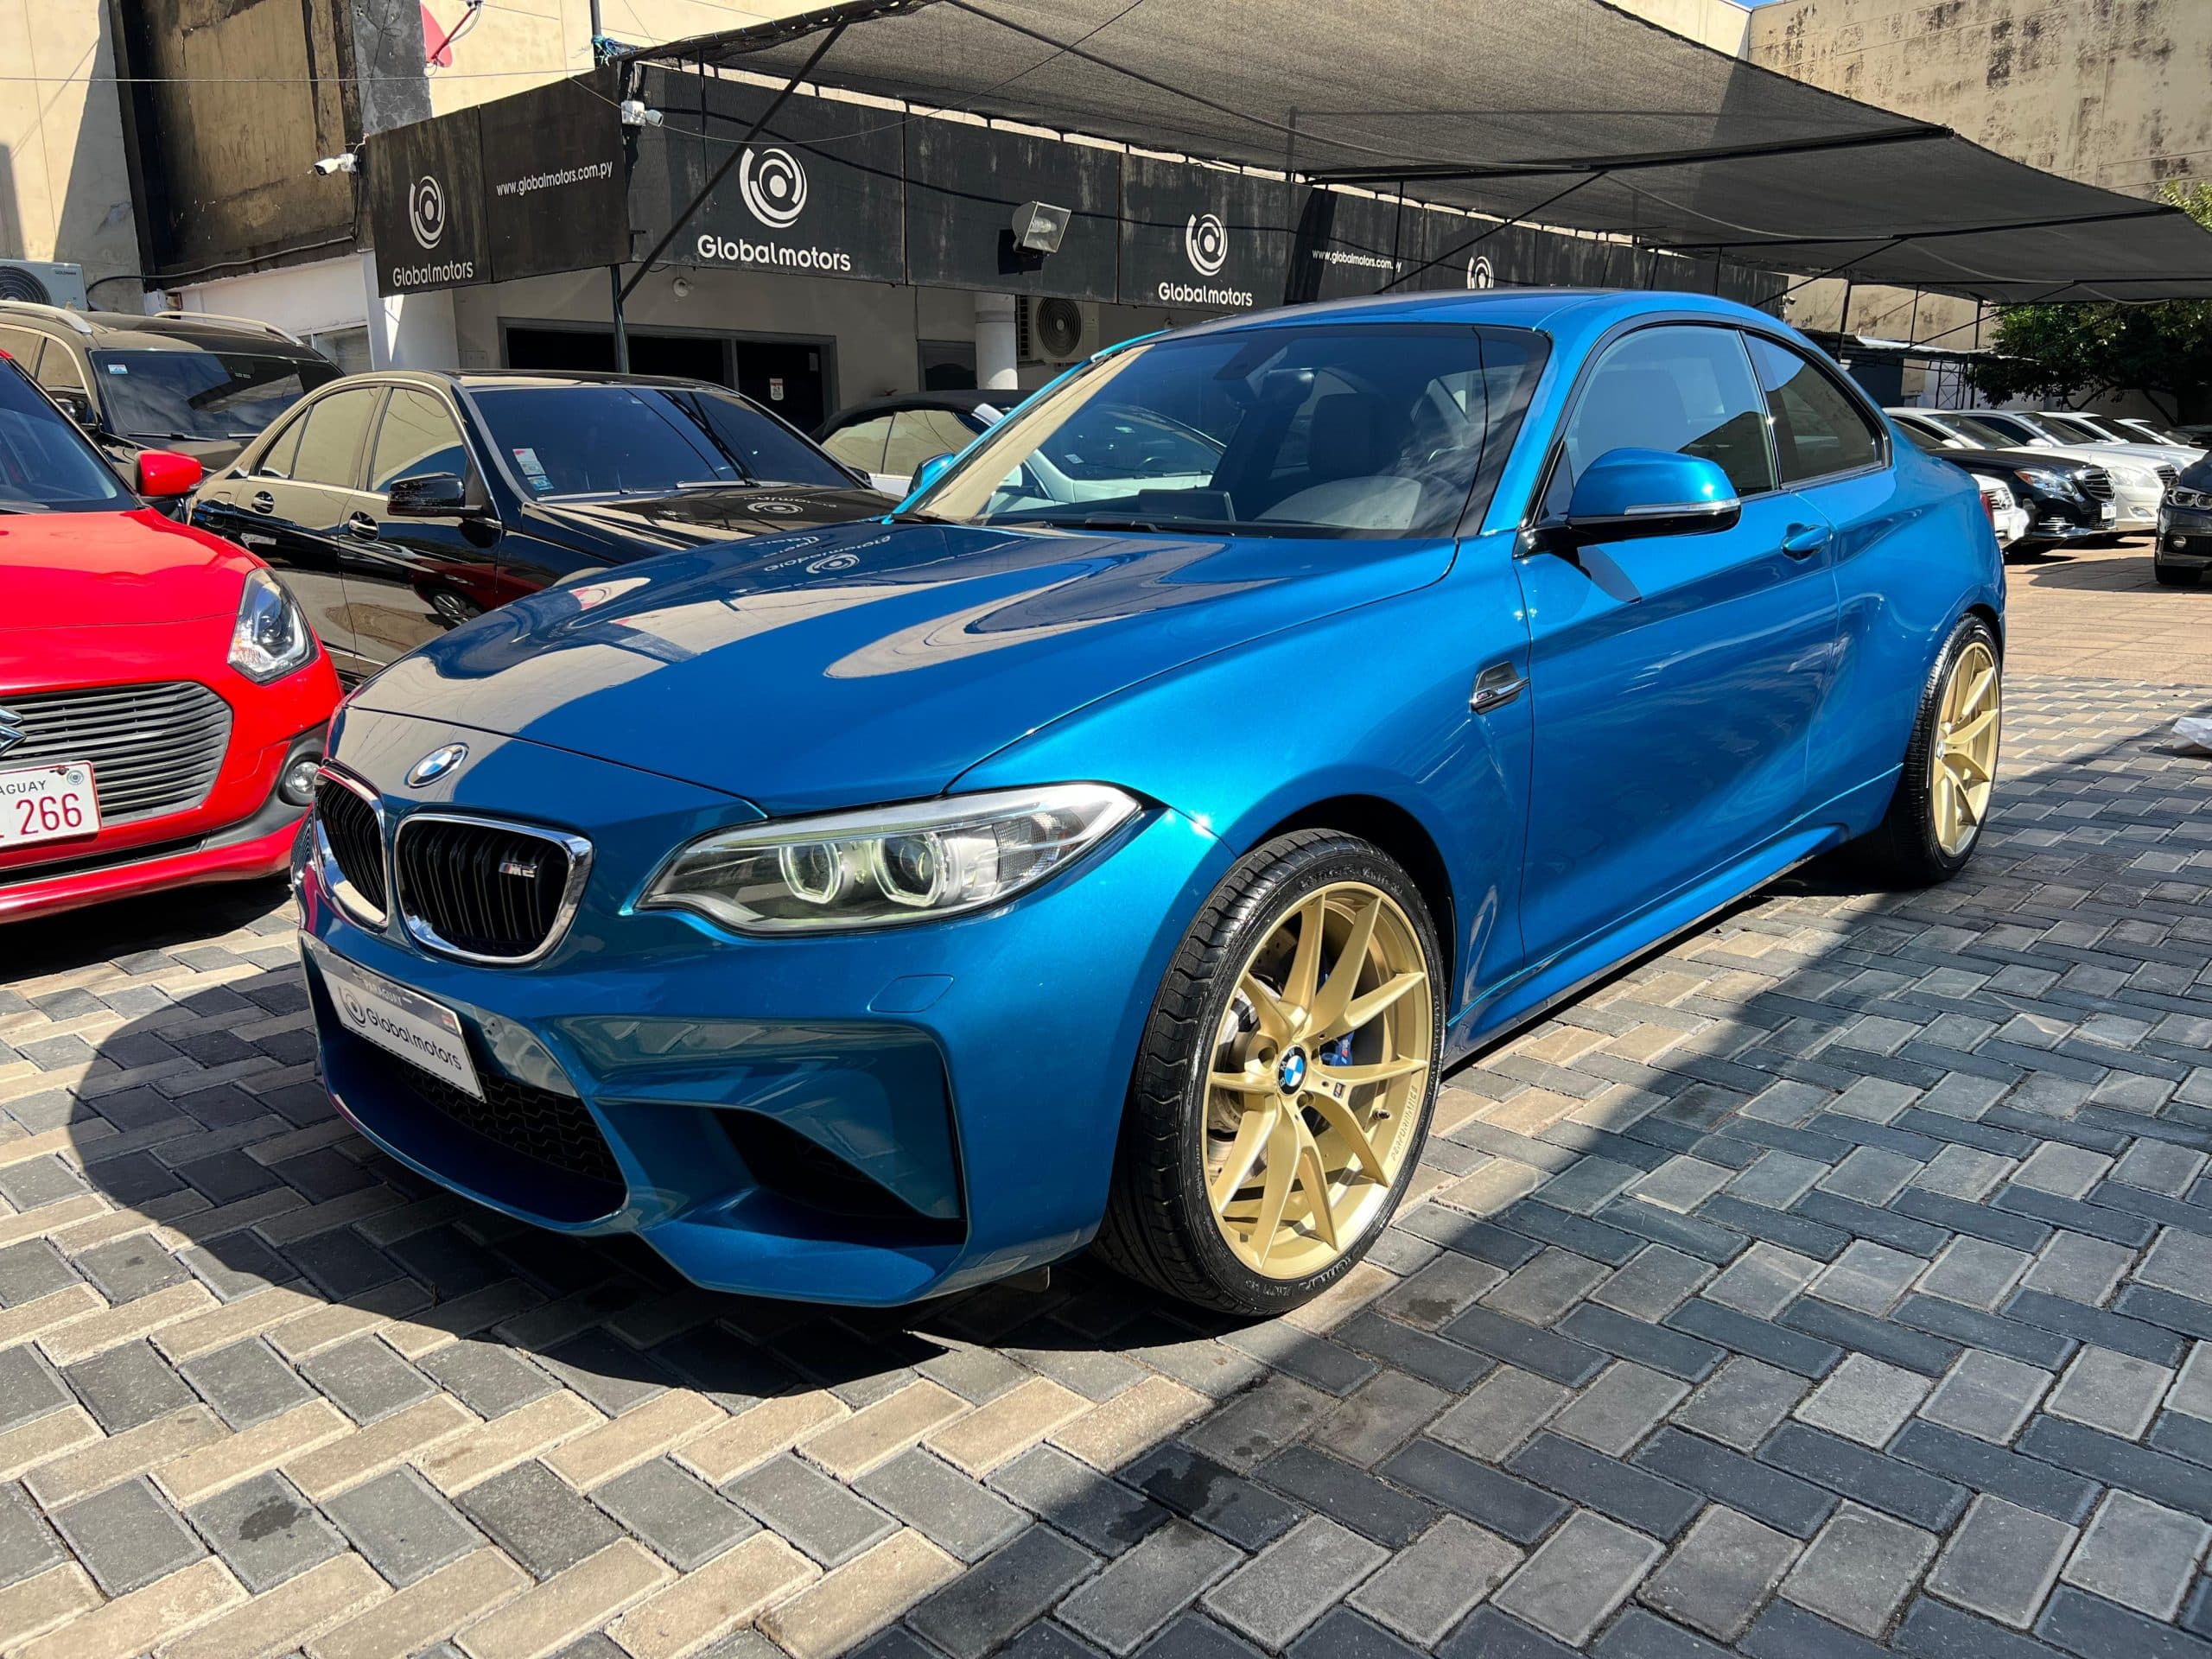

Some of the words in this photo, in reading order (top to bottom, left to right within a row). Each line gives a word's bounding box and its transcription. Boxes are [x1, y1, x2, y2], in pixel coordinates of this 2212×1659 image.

[496, 161, 613, 196] www.globalmotors.com.py
[697, 234, 851, 271] Globalmotors
[1312, 249, 1402, 273] www.globalmotors.com.y
[392, 260, 474, 287] Globalmotors
[1158, 282, 1253, 307] Globalmotors
[16, 793, 82, 836] 266
[365, 1007, 462, 1070] Globalmotors
